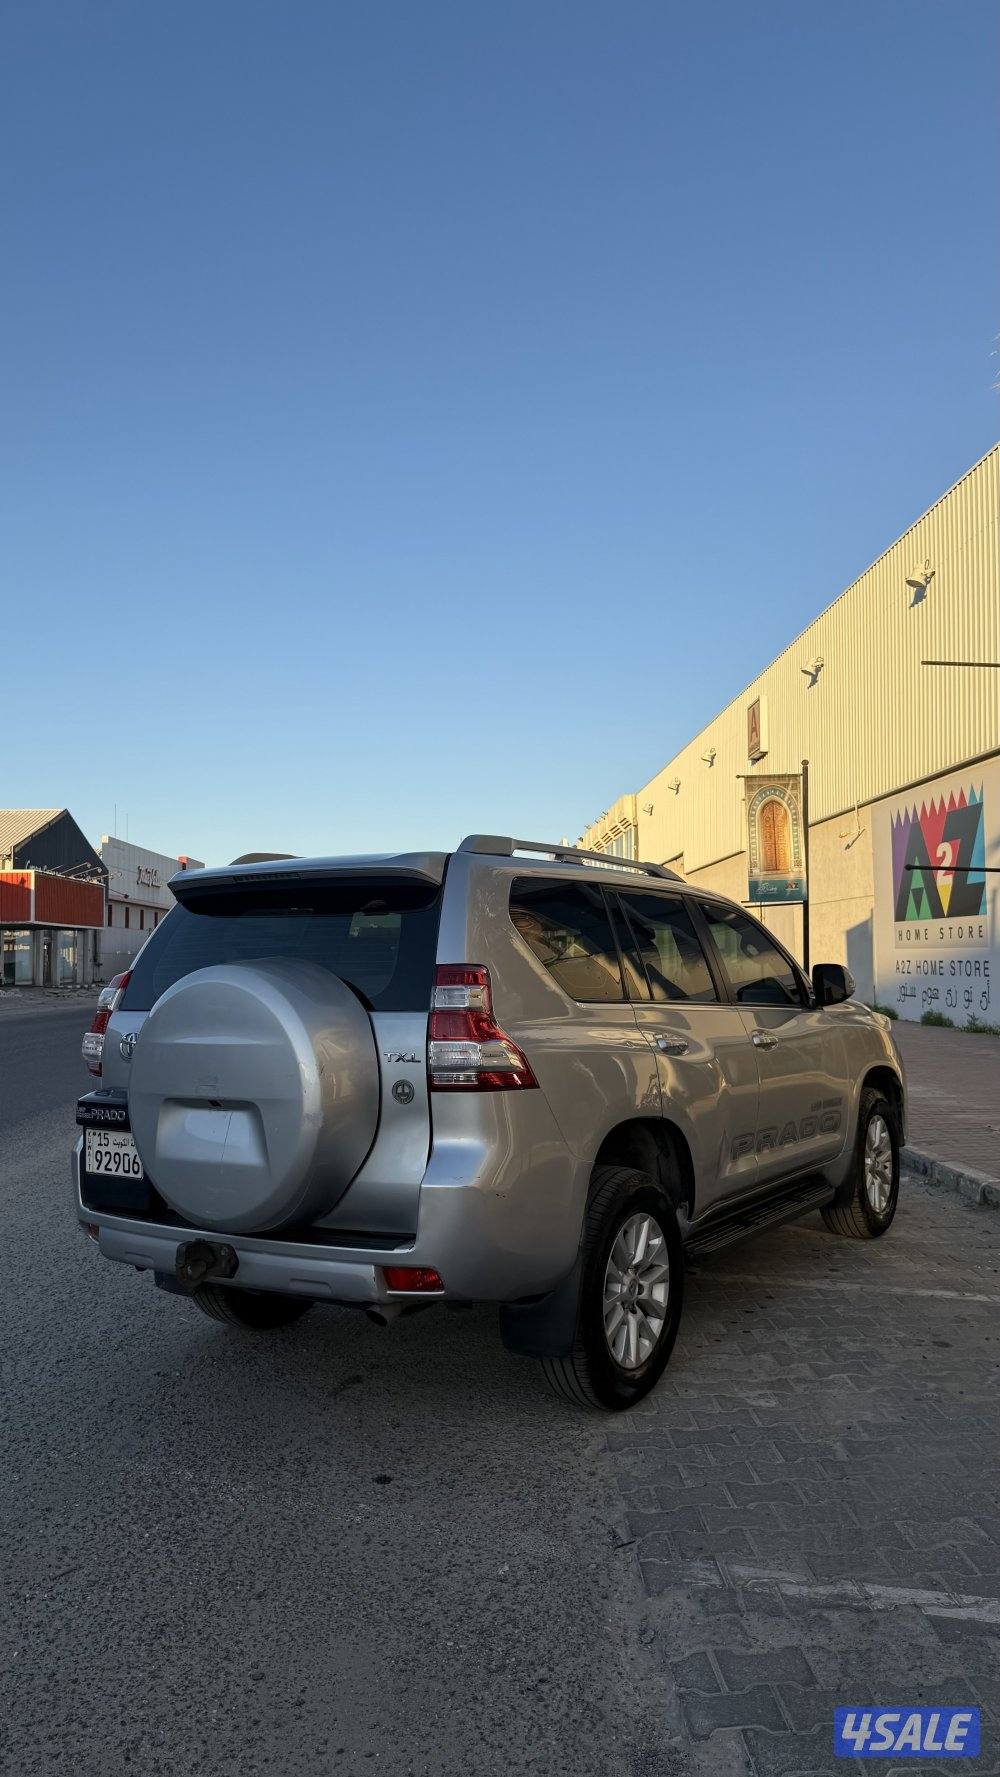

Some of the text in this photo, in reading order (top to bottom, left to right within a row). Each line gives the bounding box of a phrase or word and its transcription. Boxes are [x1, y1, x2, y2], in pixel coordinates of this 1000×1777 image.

[898, 925, 984, 941] HOME STORE
[895, 960, 990, 978] A2Z HOME STORE
[90, 1108, 126, 1121] PRADO
[97, 1132, 110, 1147] 15
[94, 1149, 140, 1175] 92906
